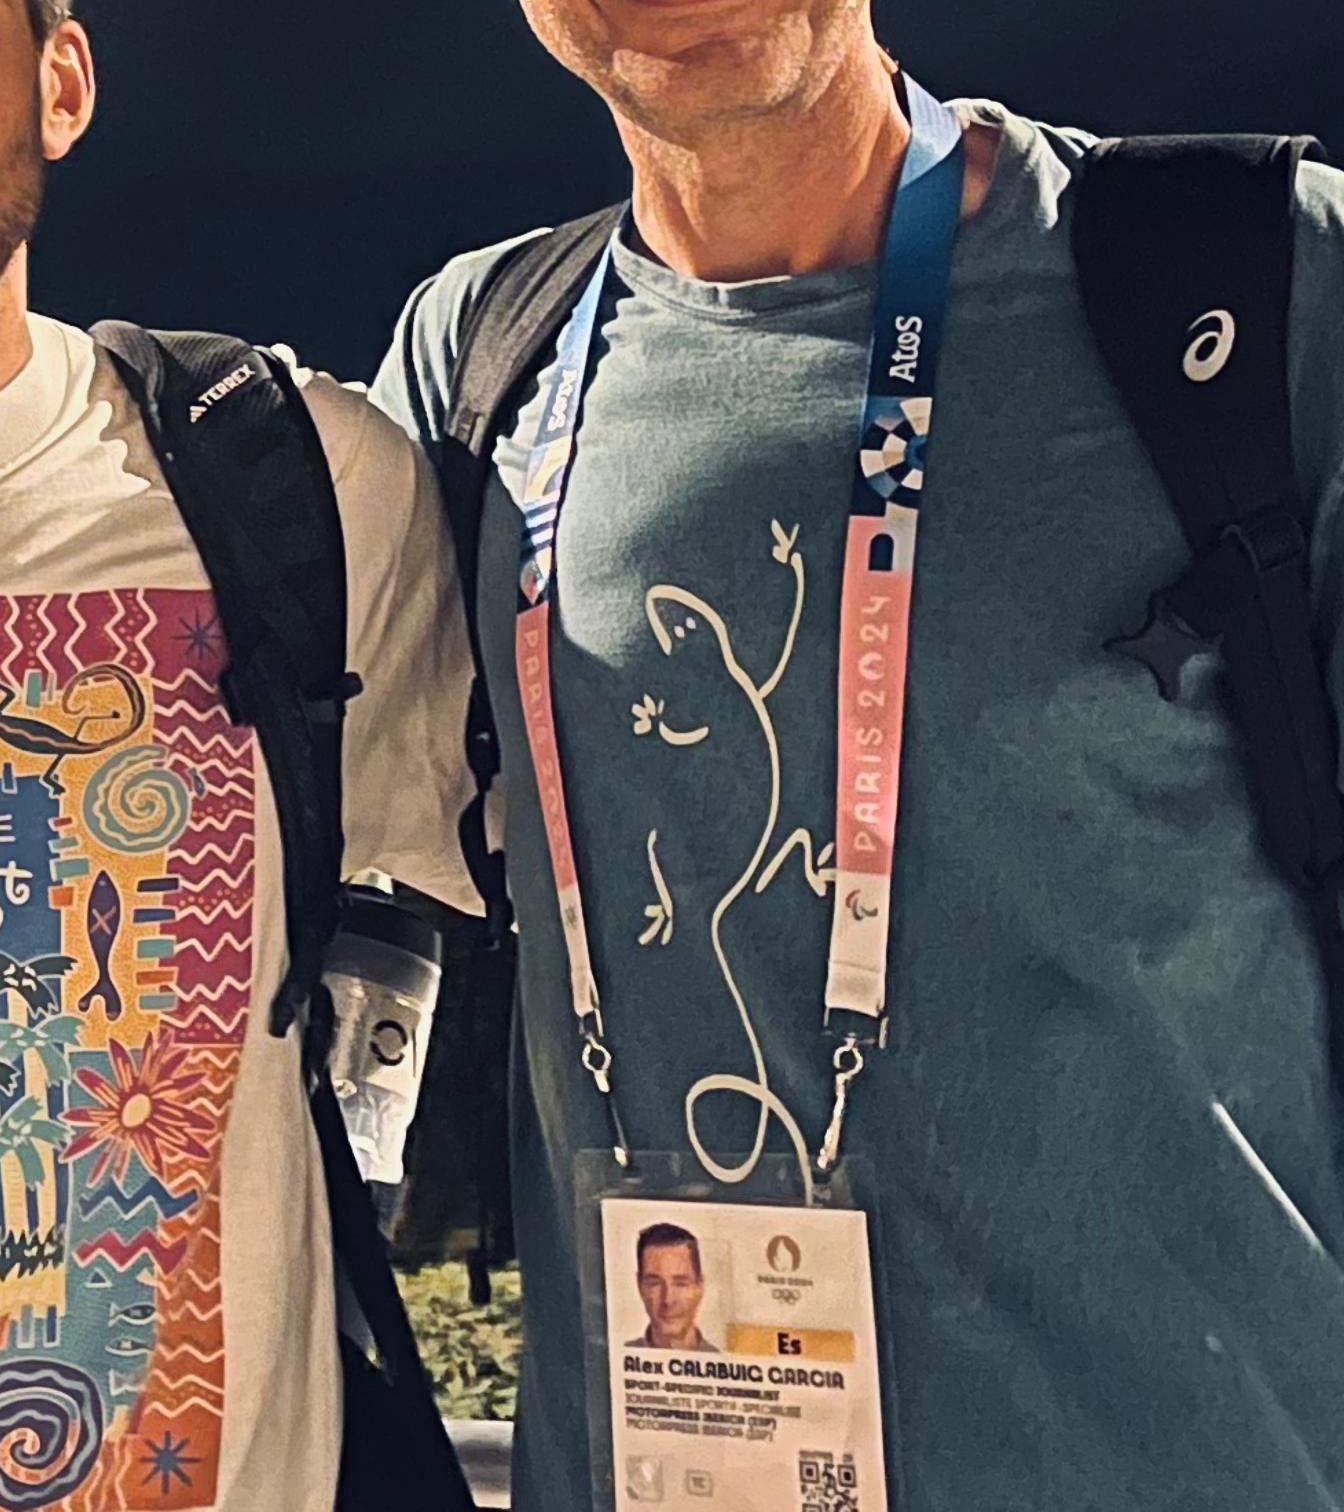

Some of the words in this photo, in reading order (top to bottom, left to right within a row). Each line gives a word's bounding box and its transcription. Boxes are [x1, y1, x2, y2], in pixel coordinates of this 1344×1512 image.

[890, 313, 923, 383] Atos
[198, 364, 256, 406] TERREX
[856, 592, 892, 704] 2024
[853, 721, 886, 854] PARIS
[777, 1332, 801, 1355] Es
[623, 1355, 663, 1375] Alex
[668, 1359, 763, 1383] CALABUIG
[768, 1366, 845, 1390] GARCIA
